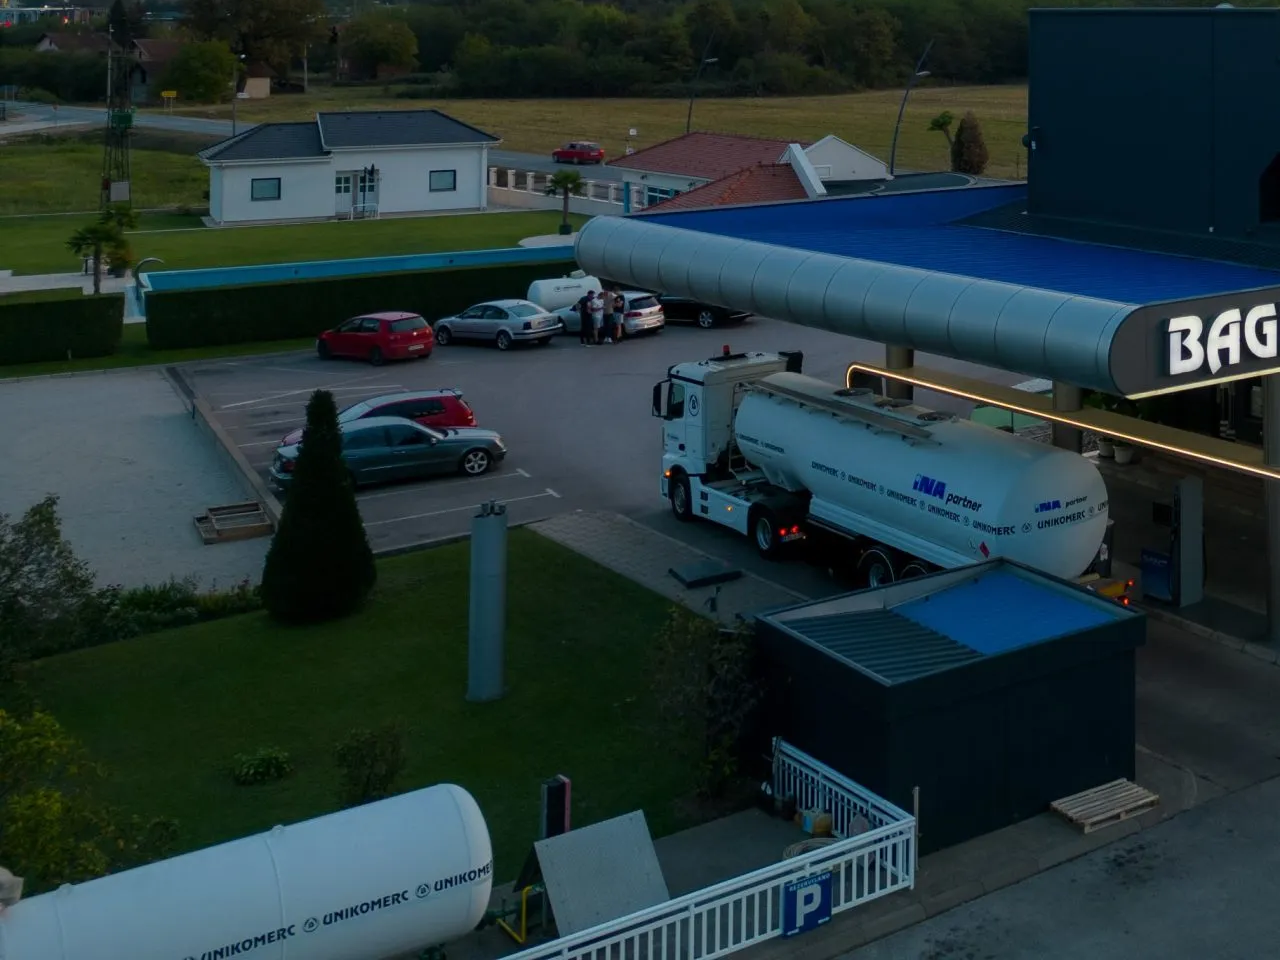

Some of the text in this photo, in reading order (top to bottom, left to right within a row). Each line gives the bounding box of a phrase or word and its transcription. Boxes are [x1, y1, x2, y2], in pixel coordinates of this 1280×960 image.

[928, 504, 960, 523] UNIKOMERC
[972, 520, 1015, 536] UNIKOMERC
[1037, 511, 1086, 529] UNIKOMERC
[946, 492, 982, 513] partner
[201, 924, 296, 960] UNIKOMERC
[322, 890, 409, 926] UNIKOMERC
[796, 884, 822, 928] P
